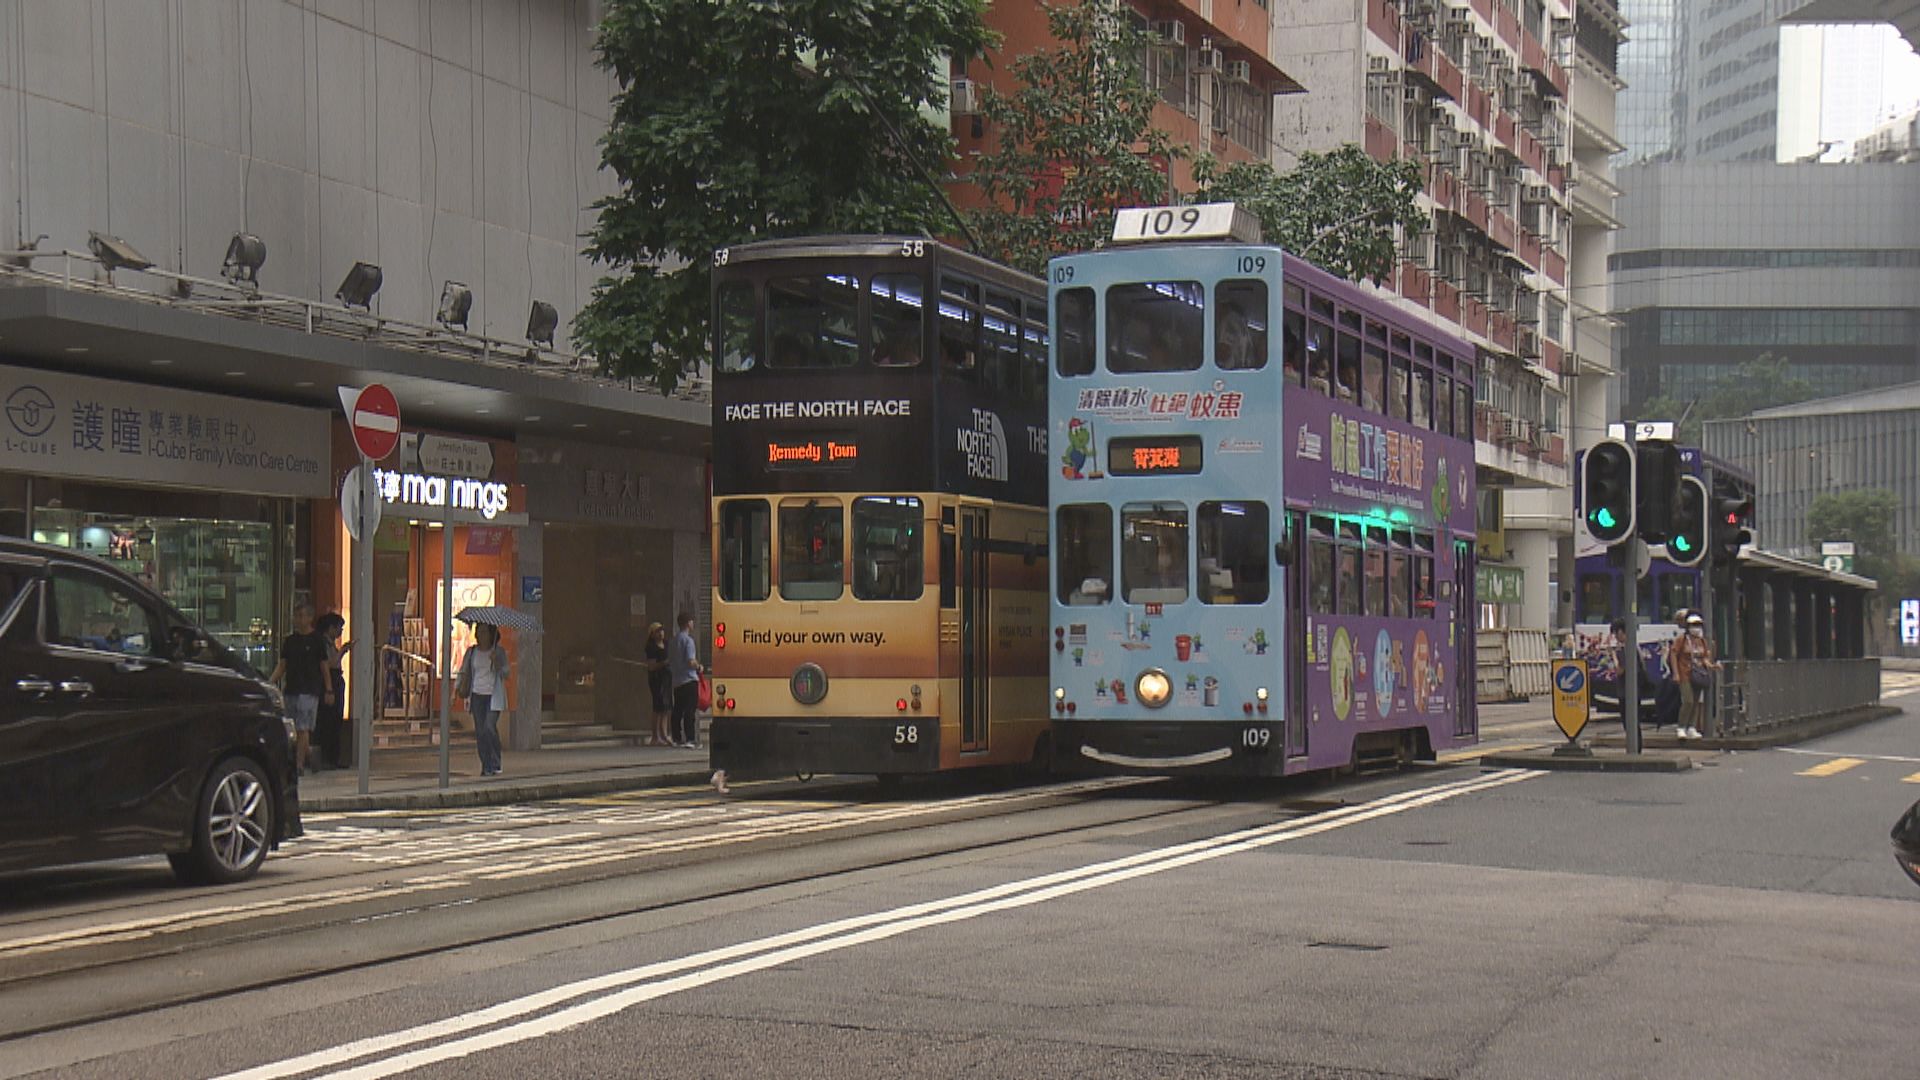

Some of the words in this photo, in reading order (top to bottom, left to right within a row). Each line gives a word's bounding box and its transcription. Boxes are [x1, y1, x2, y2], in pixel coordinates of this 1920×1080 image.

[1140, 208, 1200, 236] 109
[714, 248, 729, 267] 58
[902, 240, 924, 257] 58
[1053, 266, 1074, 284] 109
[1237, 256, 1266, 273] 109
[725, 405, 760, 421] FACE
[763, 402, 794, 419] THE
[798, 400, 859, 418] NORTH
[863, 400, 911, 416] FACE
[1078, 388, 1148, 410] 清除積水
[1150, 393, 1242, 419] 杜絕蚊患
[72, 400, 142, 455] 護瞳
[149, 409, 256, 446] 專業驗眼中心
[972, 408, 992, 433] THE
[769, 442, 821, 462] Kennedy
[828, 441, 857, 458] Town
[957, 427, 992, 456] NORTH
[1027, 425, 1047, 455] THE
[148, 440, 186, 459] I-Cube
[188, 443, 224, 469] Family
[226, 448, 258, 467] Vision
[259, 451, 284, 471] Care
[286, 454, 319, 474] Centre
[967, 454, 992, 479] FACE
[743, 629, 771, 644] Find
[775, 632, 809, 647] your
[812, 632, 845, 643] own
[850, 632, 886, 647] way.
[895, 726, 918, 744] 58
[1242, 728, 1270, 747] 109
